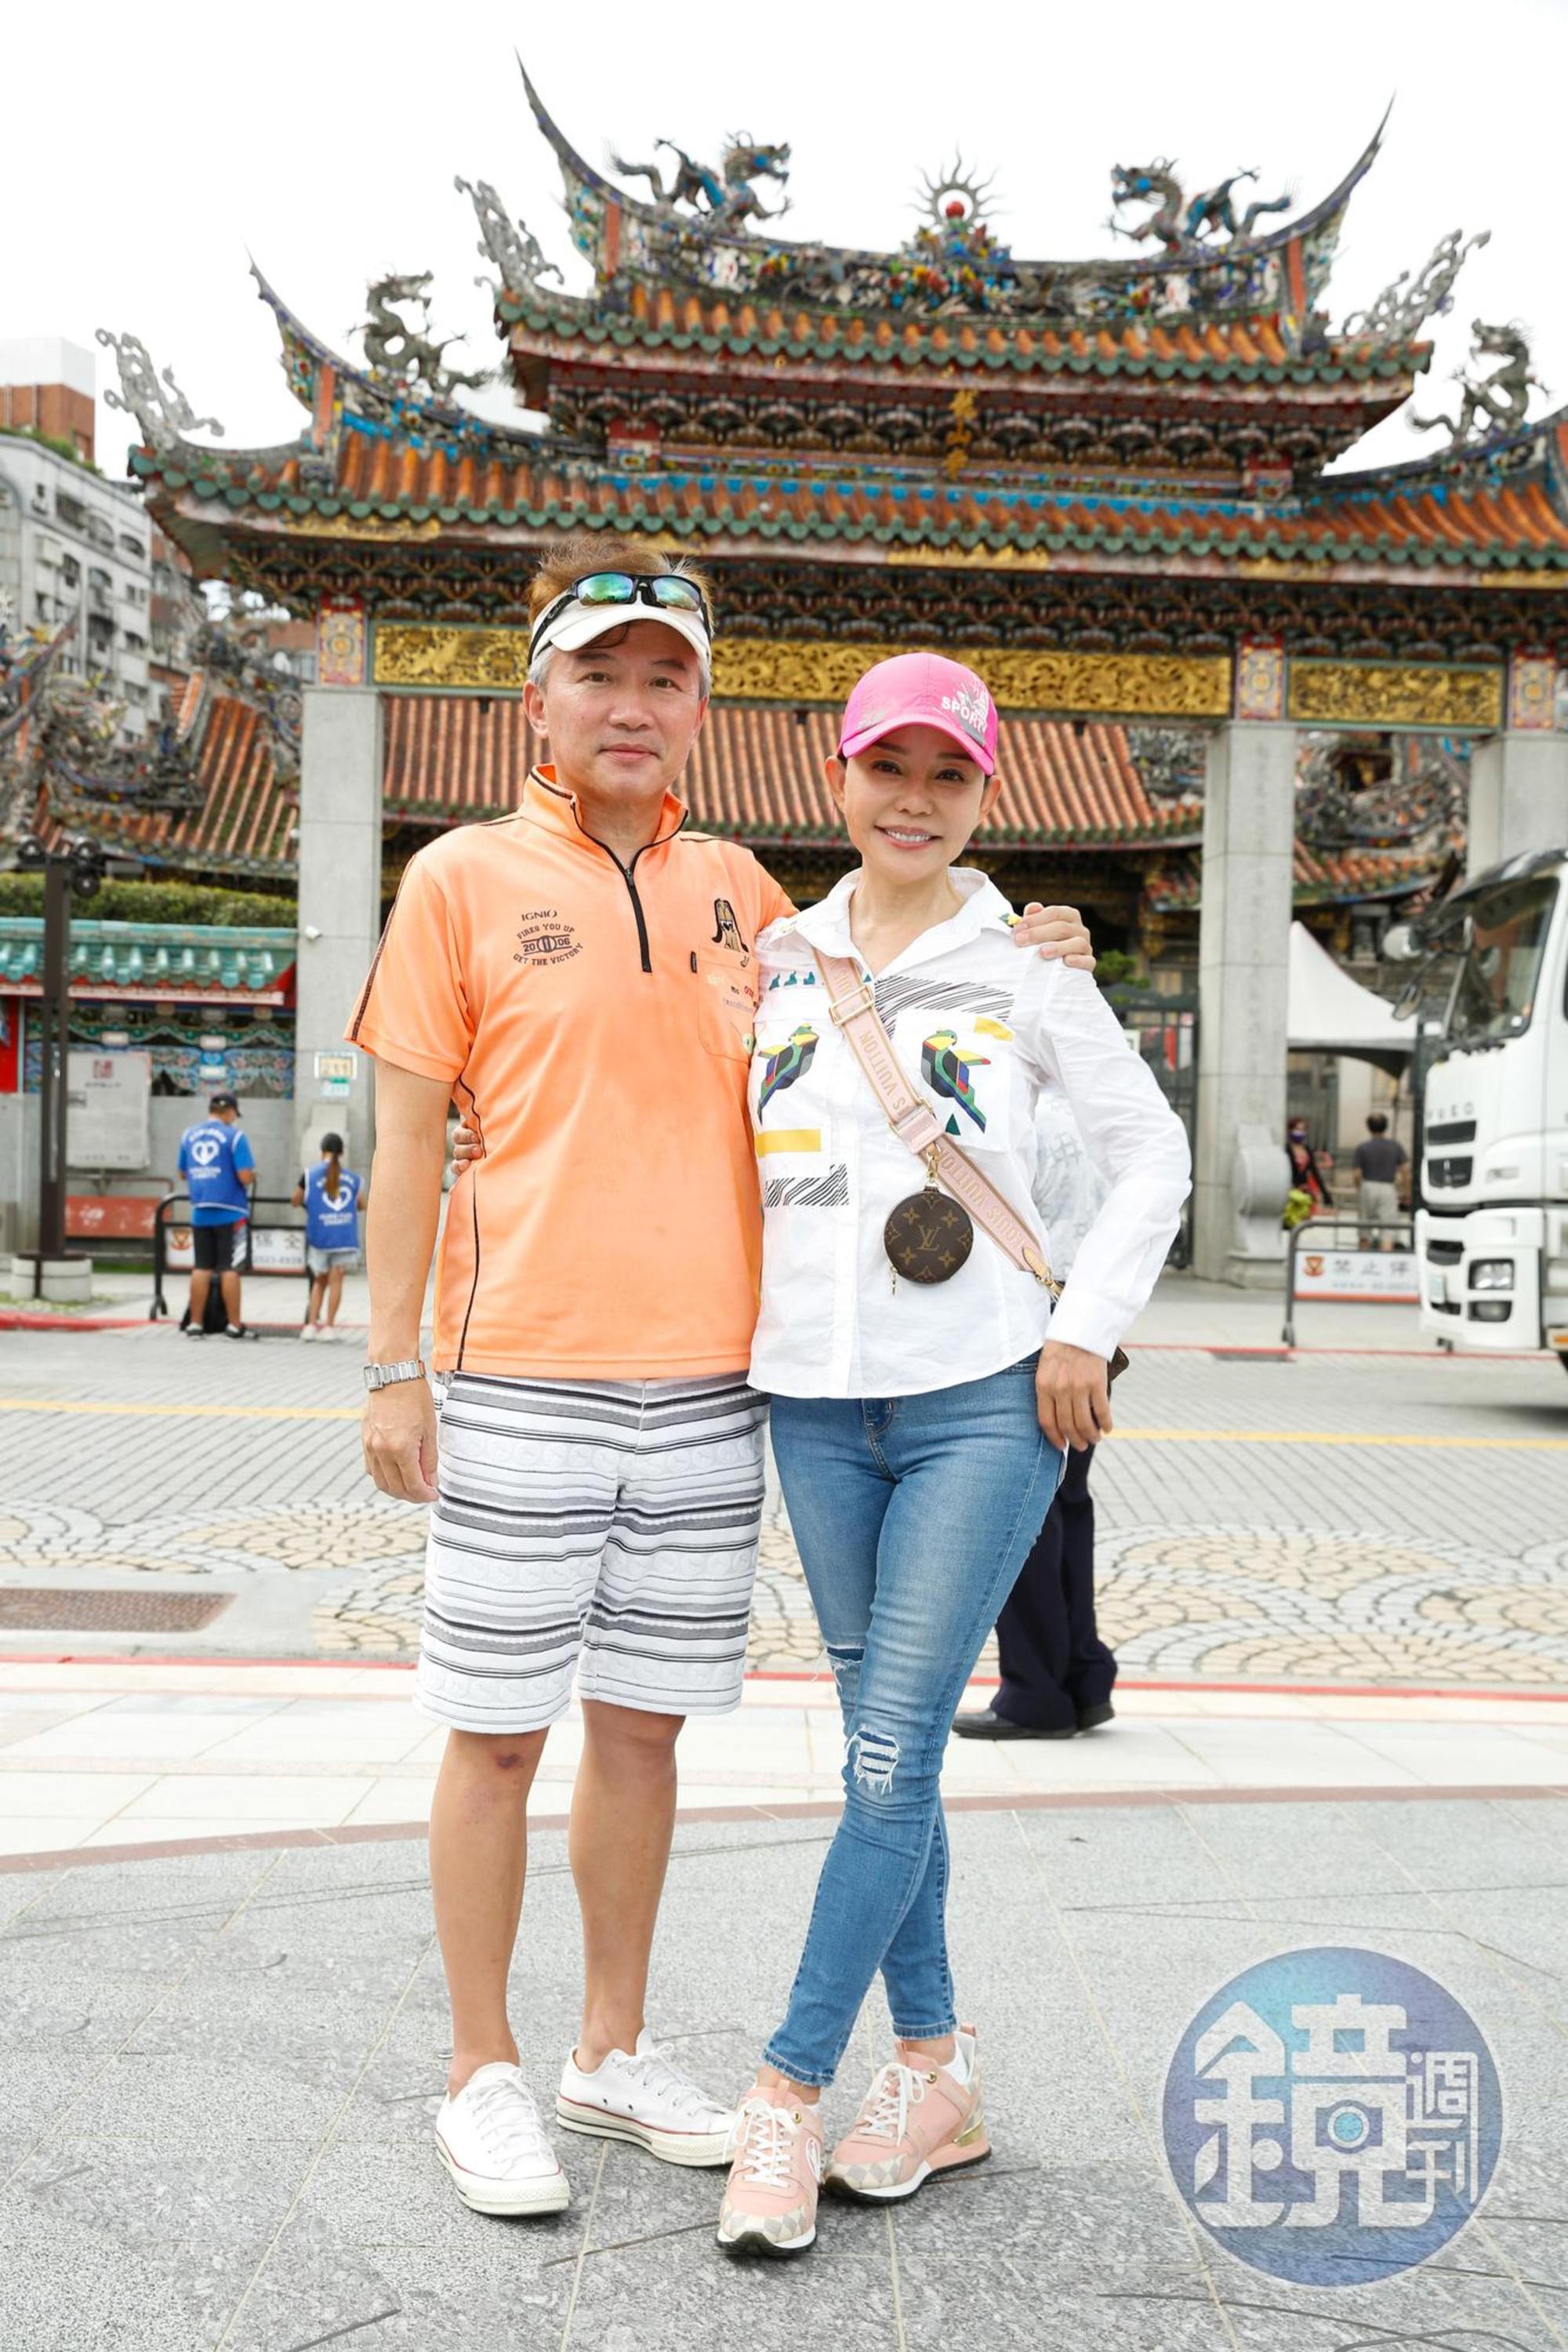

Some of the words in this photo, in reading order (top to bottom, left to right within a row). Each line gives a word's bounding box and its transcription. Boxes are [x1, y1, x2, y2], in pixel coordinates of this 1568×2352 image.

[521, 909, 557, 921] IGNIO
[513, 953, 528, 964] GET
[550, 942, 583, 964] VICTORY
[859, 1029, 898, 1097] VUITTON
